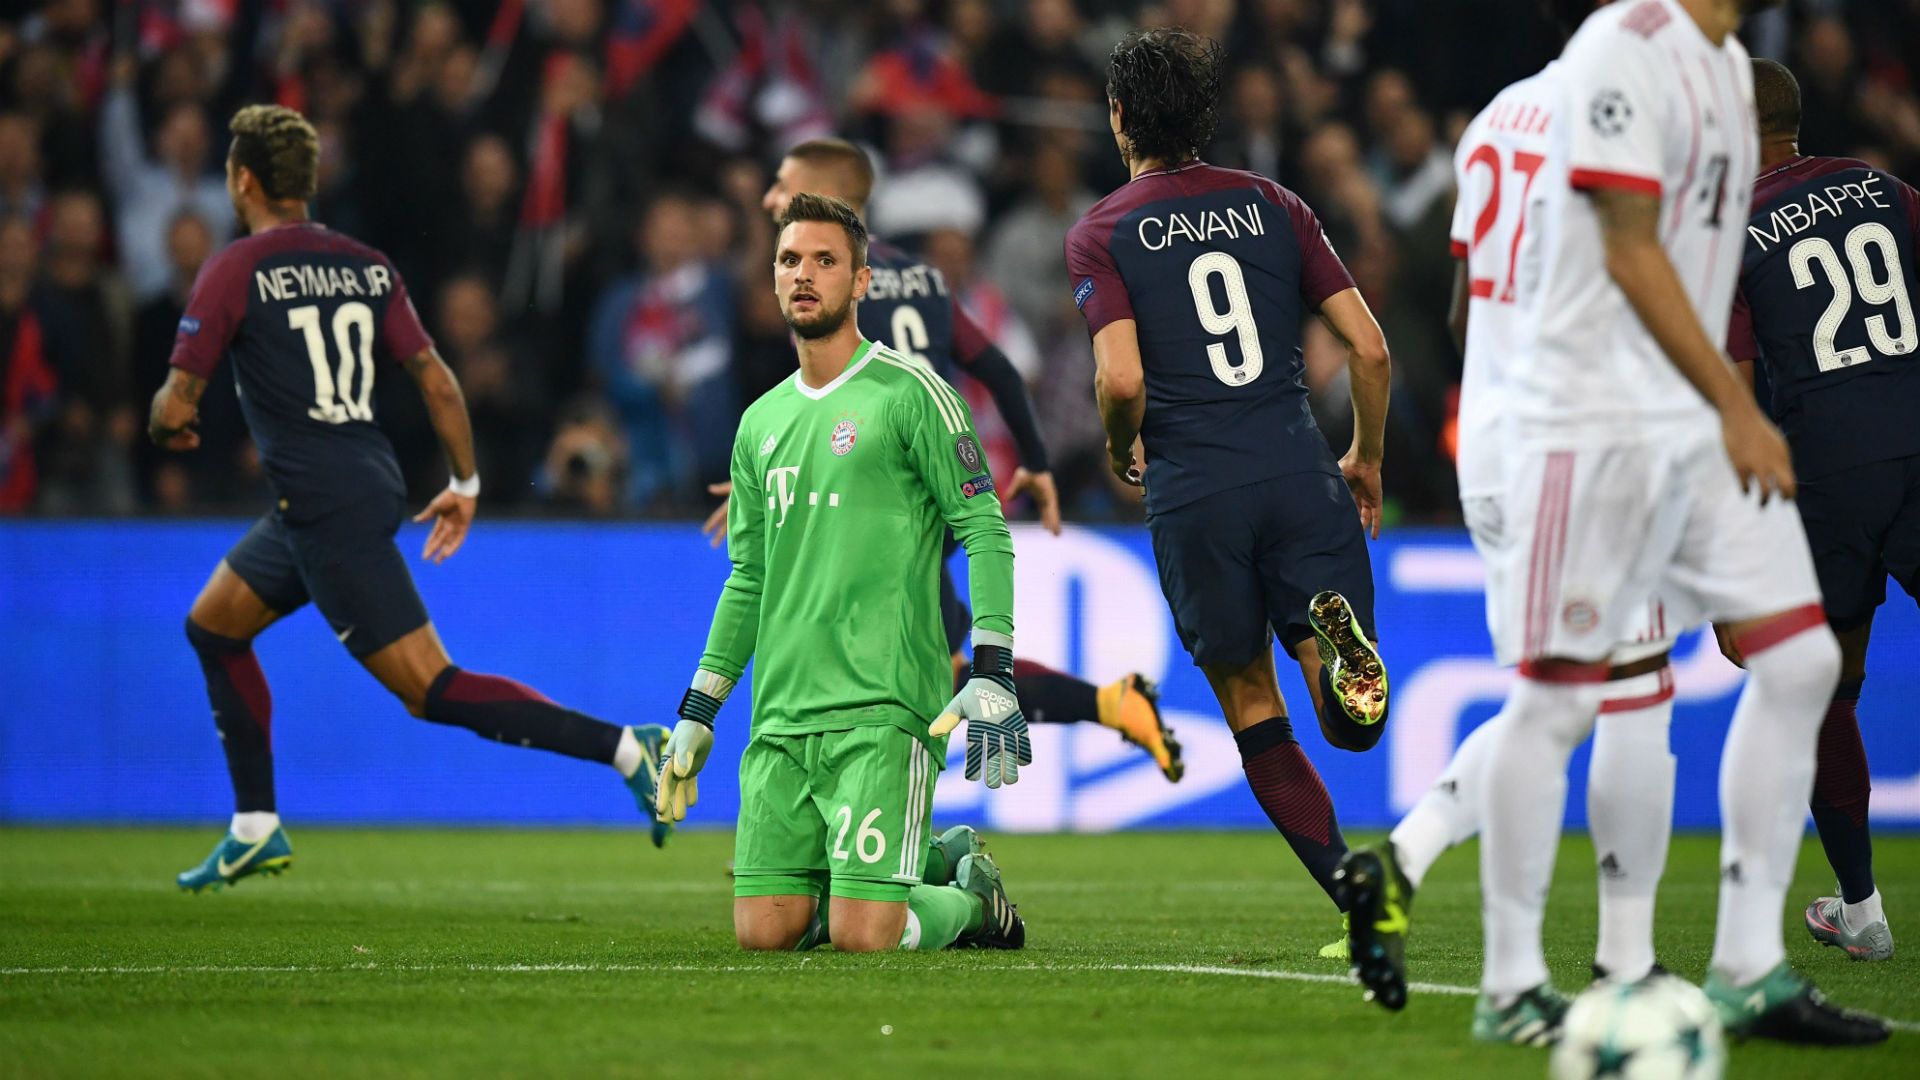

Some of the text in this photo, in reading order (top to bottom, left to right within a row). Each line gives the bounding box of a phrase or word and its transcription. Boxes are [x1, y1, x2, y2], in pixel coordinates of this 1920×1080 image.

[1138, 203, 1264, 250] CAVANI
[1465, 144, 1545, 303] 27
[1747, 171, 1890, 251] MBAPPÉ
[255, 264, 392, 303] NEYMAR JR
[1188, 251, 1263, 387] 9
[1788, 222, 1918, 372] 29
[288, 301, 374, 424] 10
[975, 687, 1014, 708] adidas
[832, 806, 886, 864] 26
